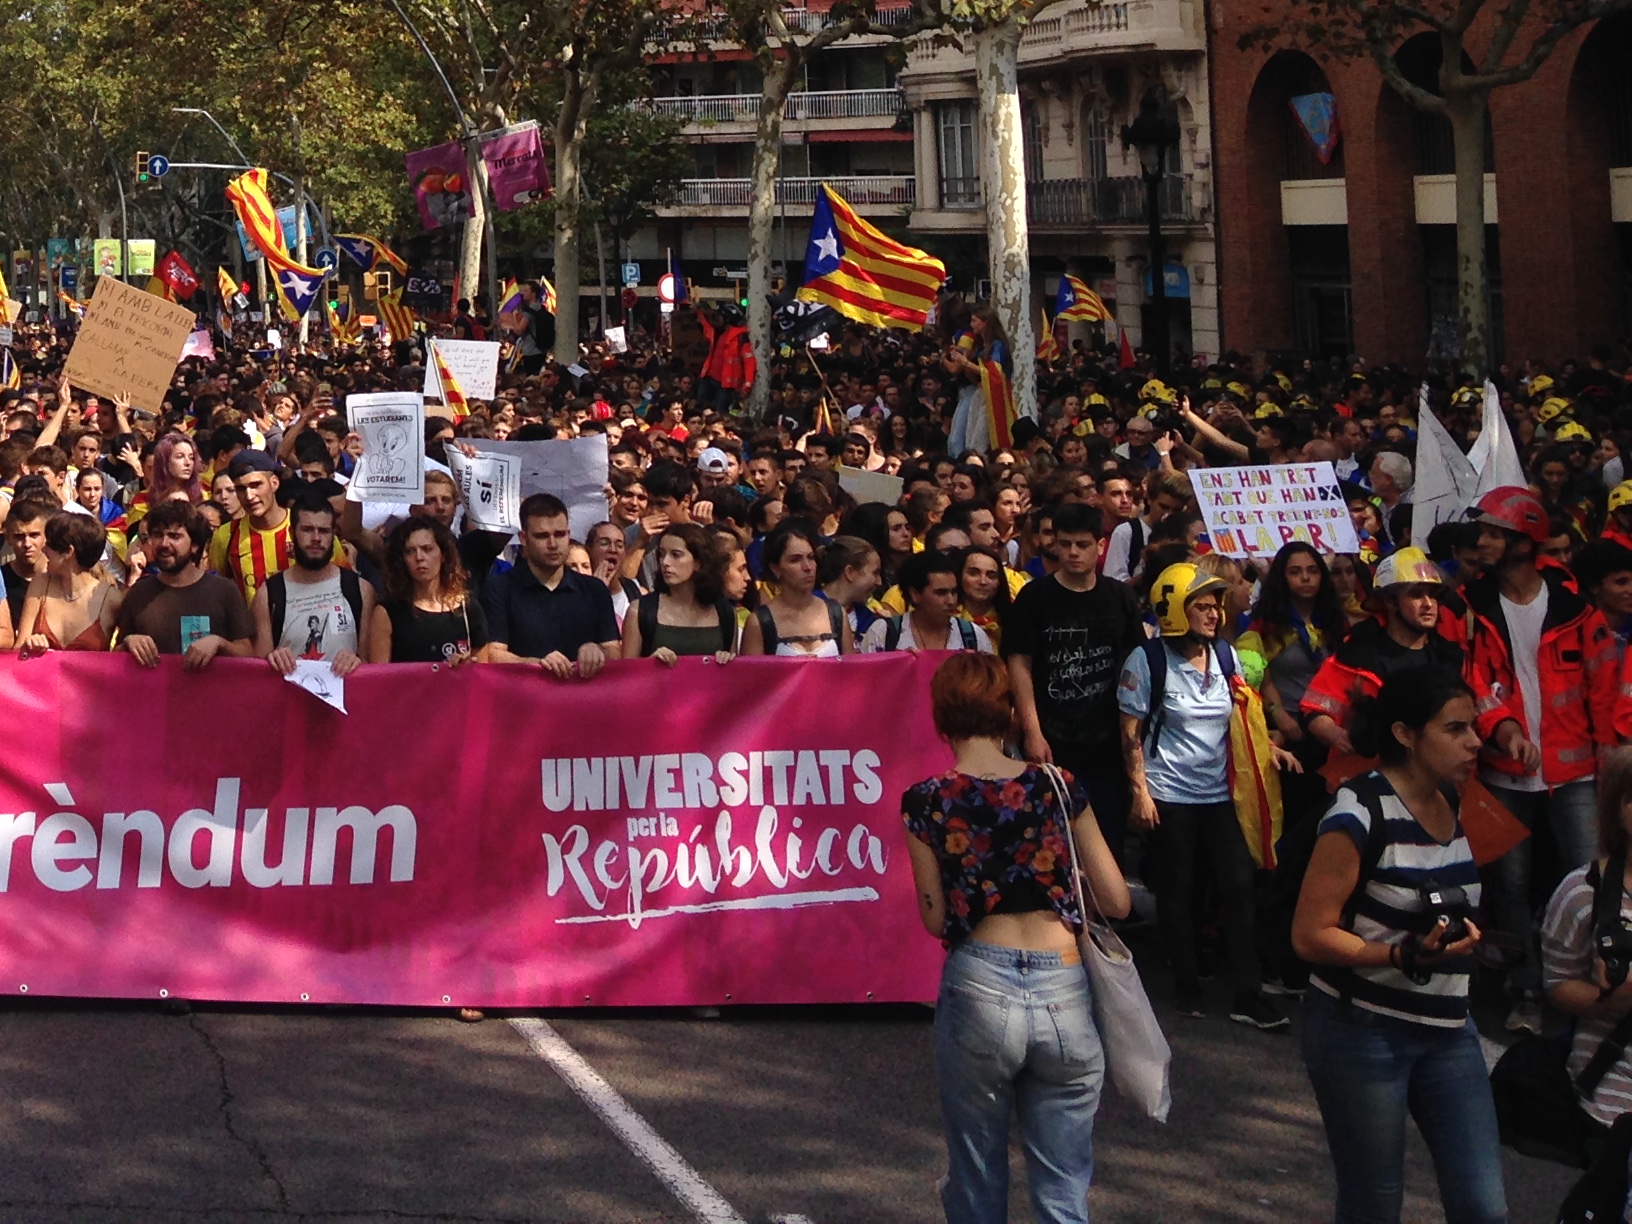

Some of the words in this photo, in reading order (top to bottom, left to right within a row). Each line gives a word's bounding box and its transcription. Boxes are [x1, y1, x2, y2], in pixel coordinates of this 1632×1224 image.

[117, 290, 153, 312] AMB
[1199, 472, 1232, 488] ENS
[1237, 469, 1272, 487] HAN
[1276, 467, 1316, 485] TRET
[1202, 491, 1242, 506] TANT
[1247, 490, 1276, 505] QUE
[1280, 487, 1316, 503] HAN
[1212, 510, 1264, 525] ACABAT
[1235, 526, 1277, 552] LA
[542, 749, 882, 812] UNIVERSITATS
[628, 815, 658, 841] per
[660, 812, 678, 837] la
[542, 806, 889, 929] República
